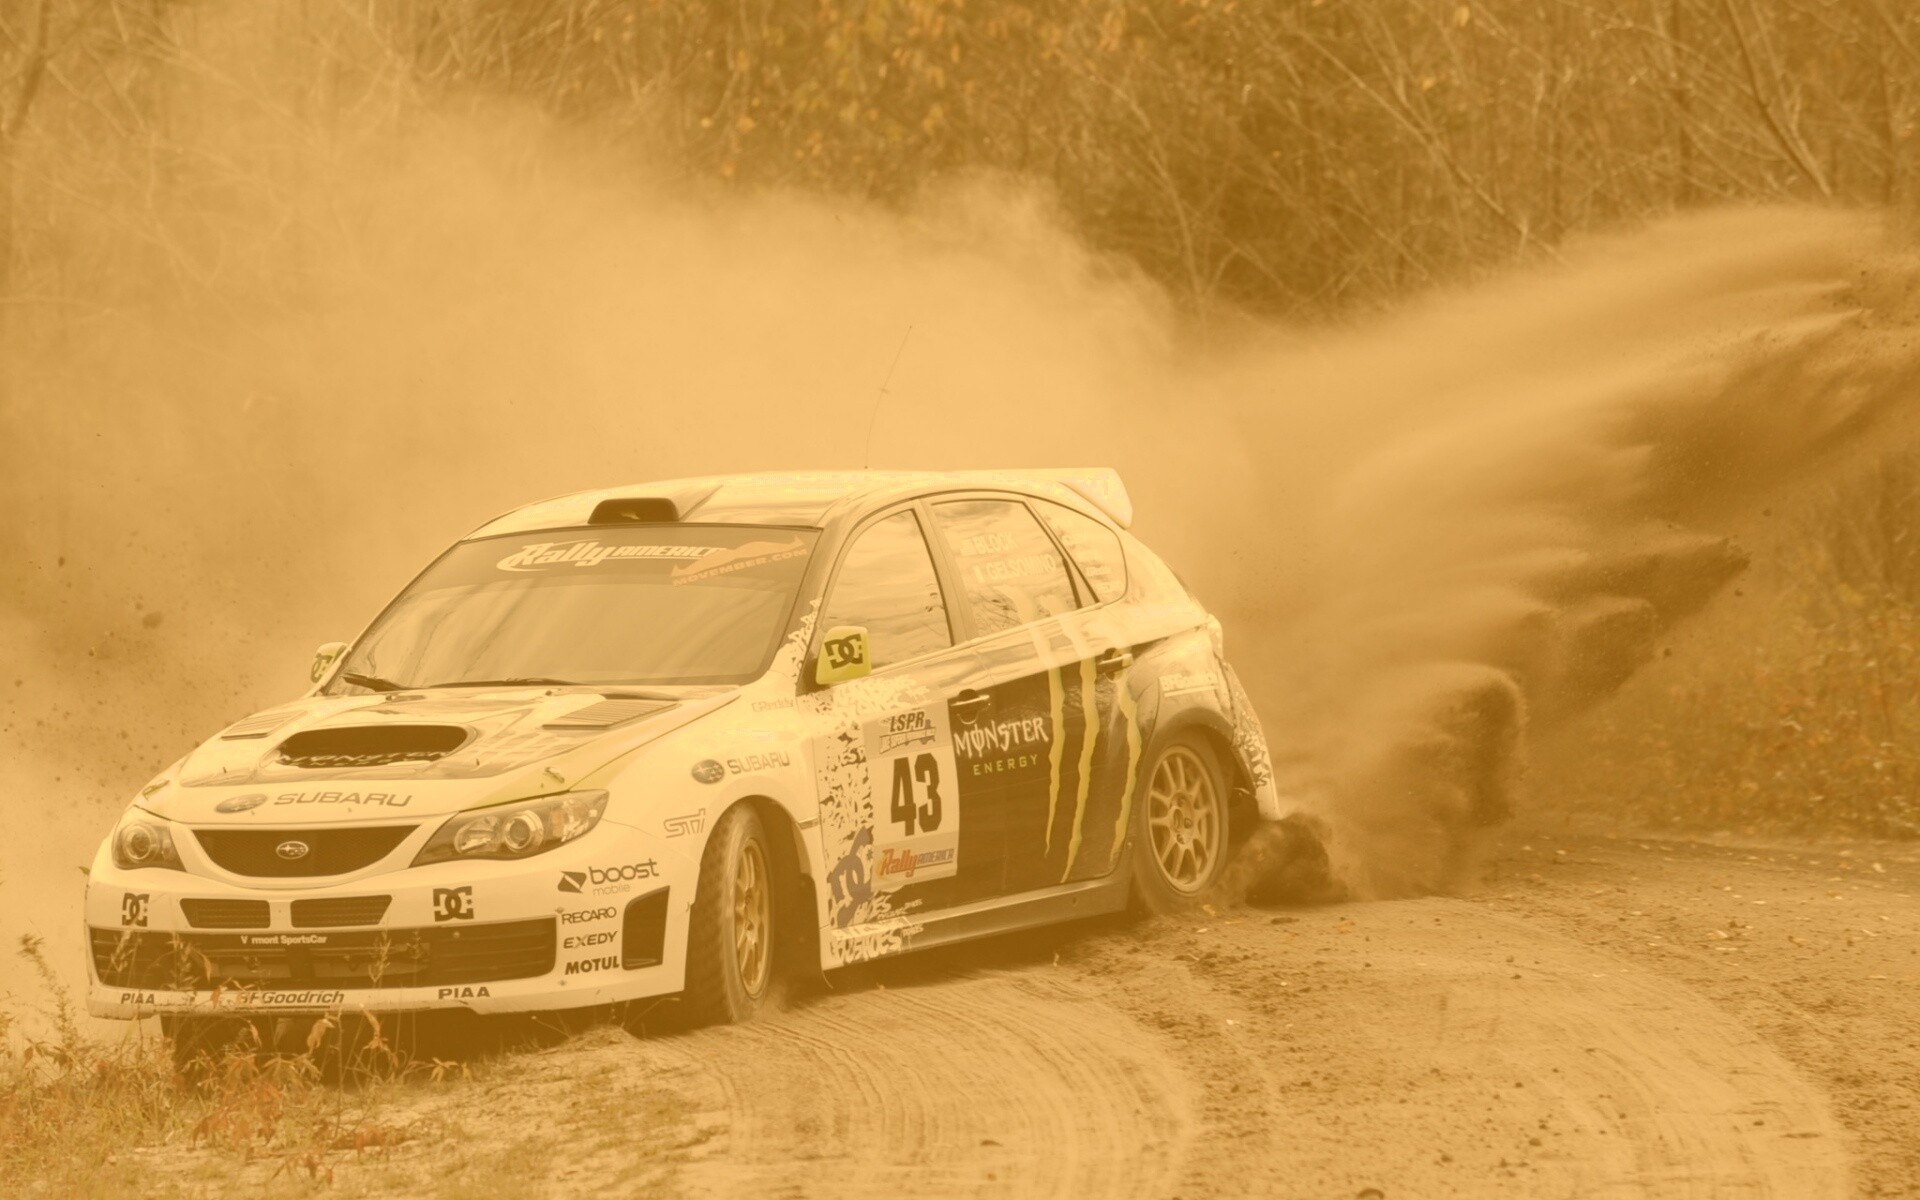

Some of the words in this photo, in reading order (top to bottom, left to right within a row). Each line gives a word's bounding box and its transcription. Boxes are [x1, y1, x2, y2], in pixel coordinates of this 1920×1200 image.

[498, 539, 611, 570] Rally
[611, 545, 727, 559] AMERIC
[672, 548, 808, 588] MOVEMBER.COM
[889, 710, 926, 733] LSPR
[726, 752, 791, 775] SUBARU
[972, 753, 1039, 776] ENERGY
[273, 791, 413, 807] SUBARU
[890, 752, 942, 837] 43
[588, 857, 660, 885] boost
[592, 883, 631, 895] mobile
[561, 906, 617, 925] RECARO
[240, 935, 278, 945] Vrmont
[280, 935, 328, 946] SportsCar
[563, 931, 618, 949] EXEDY
[564, 956, 620, 975] MOTUL
[120, 993, 155, 1005] PIAA
[437, 986, 491, 1000] PIAA
